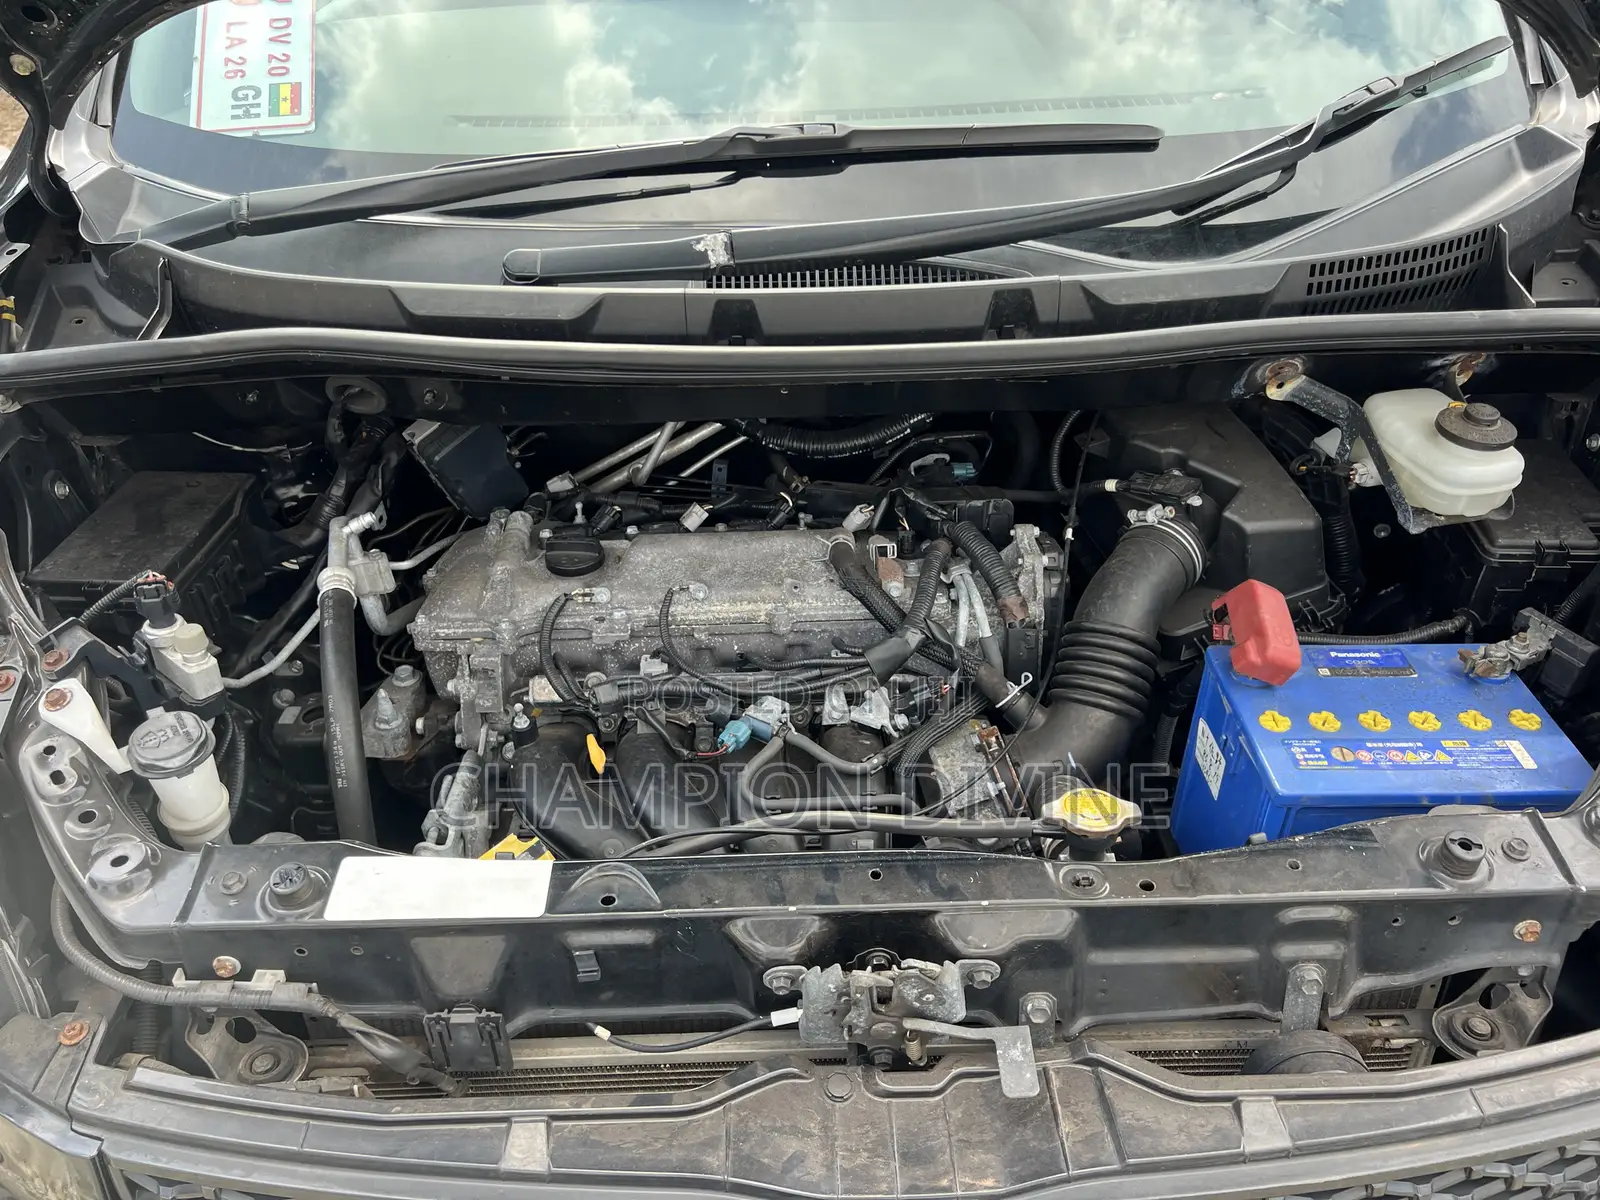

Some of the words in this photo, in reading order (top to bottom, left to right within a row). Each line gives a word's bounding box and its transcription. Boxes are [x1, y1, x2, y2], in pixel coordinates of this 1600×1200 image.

[225, 21, 248, 50] LA
[268, 17, 292, 44] DV
[223, 56, 247, 79] 26
[267, 53, 291, 77] 20
[230, 85, 262, 120] GH
